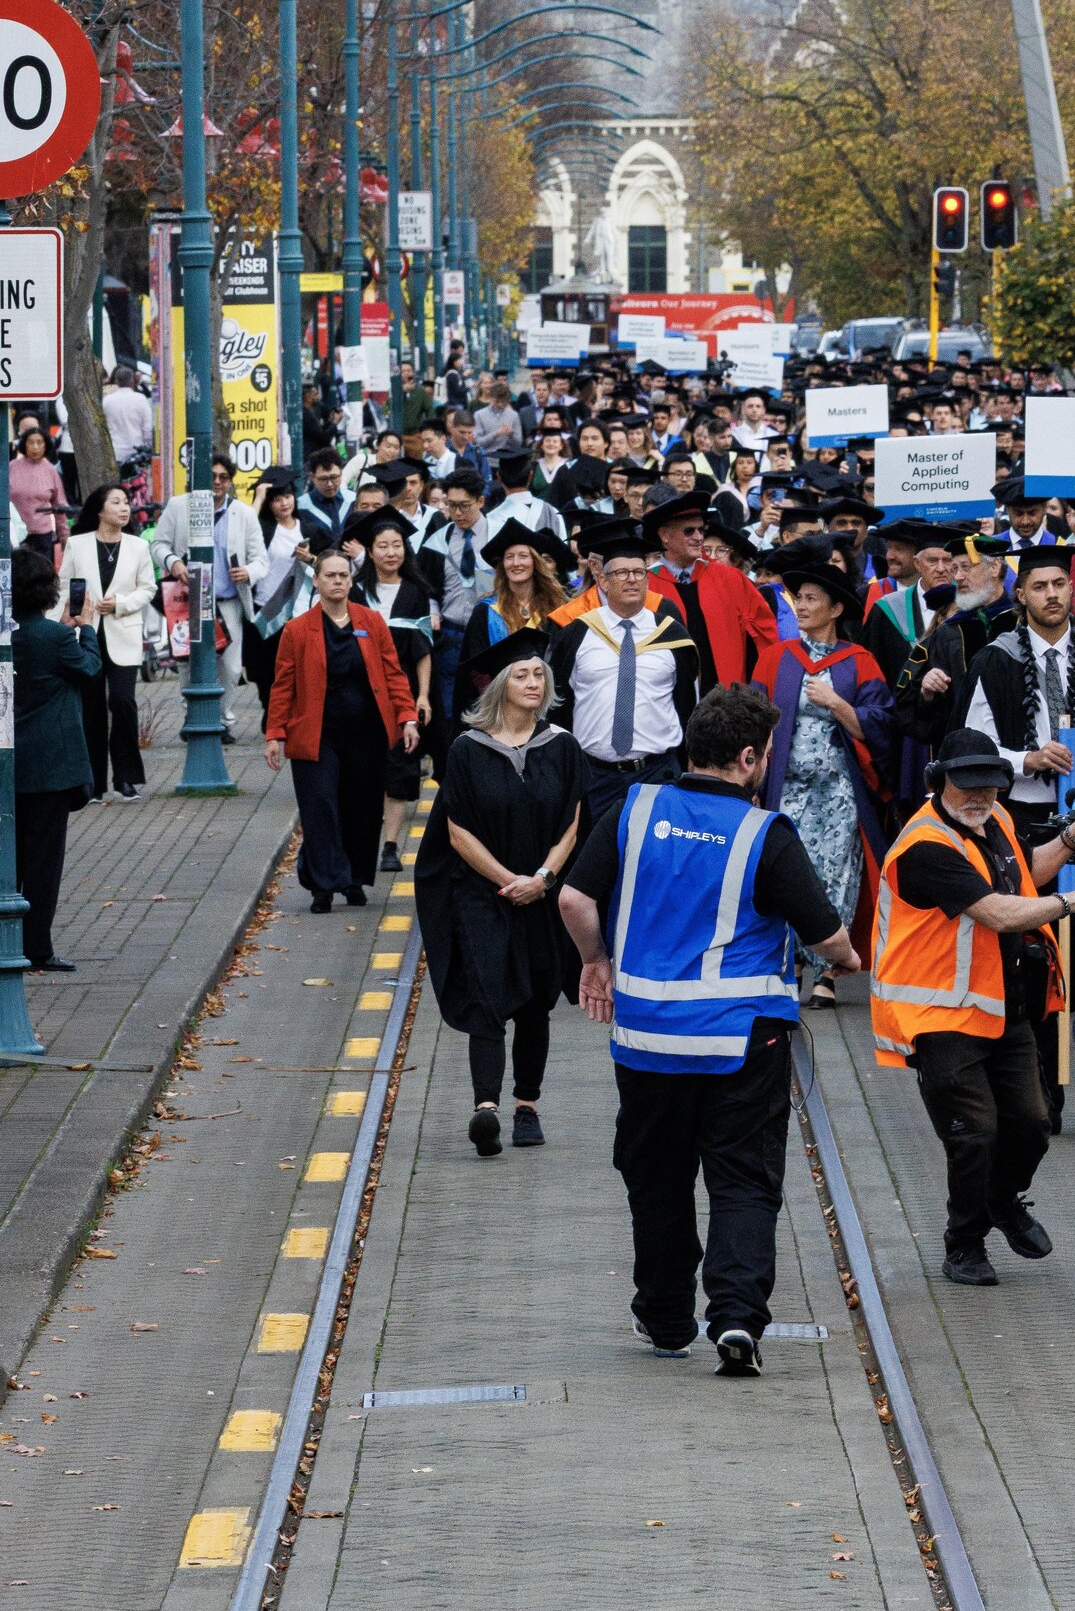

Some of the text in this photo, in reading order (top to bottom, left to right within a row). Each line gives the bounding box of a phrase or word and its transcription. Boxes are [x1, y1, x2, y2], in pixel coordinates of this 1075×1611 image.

[222, 331, 266, 365] gley
[255, 372, 269, 388] $5
[240, 397, 268, 413] shot
[827, 407, 868, 418] Masters
[907, 449, 965, 464] Master of
[911, 464, 960, 479] Applied
[901, 479, 970, 493] Computing
[189, 519, 212, 527] NOW
[671, 827, 727, 845] SHIPLEYS
